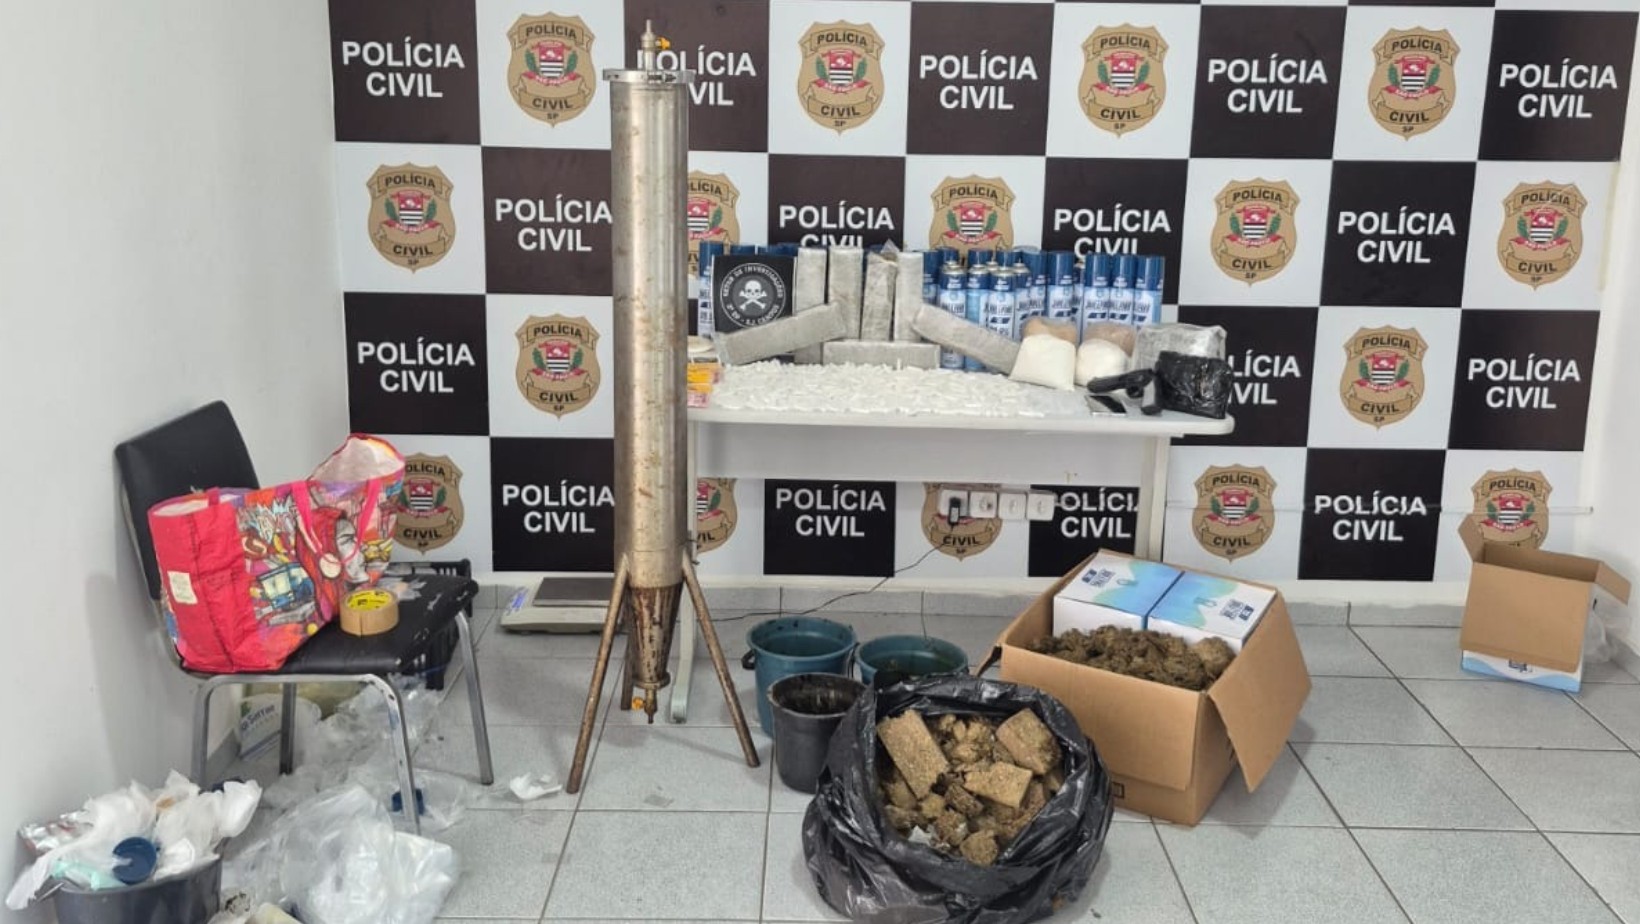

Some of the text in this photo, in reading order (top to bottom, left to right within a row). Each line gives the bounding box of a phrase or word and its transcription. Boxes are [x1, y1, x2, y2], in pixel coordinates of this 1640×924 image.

[525, 23, 577, 39] POLÍCIA
[817, 30, 867, 46] POLÍCIA
[1100, 34, 1151, 50] POLÍCIA
[342, 36, 465, 68] POLÍCIA
[1392, 37, 1442, 53] POLÍCIA
[919, 49, 1038, 81] POLÍCIA
[1207, 53, 1328, 84] POLÍCIA
[1499, 57, 1618, 89] POLÍCIA
[366, 71, 443, 98] CIVIL
[688, 81, 734, 106] VIL
[532, 97, 573, 109] CIVIL
[939, 84, 1014, 109] CIVIL
[1227, 88, 1303, 113] CIVIL
[1518, 93, 1593, 119] CIVIL
[821, 105, 861, 117] CIVIL
[1100, 108, 1141, 120] CIVIL
[1389, 111, 1430, 123] CIVIL
[385, 173, 436, 188] POLÍCIA
[689, 179, 722, 194] LÍCIA
[949, 184, 999, 199] POLÍCIA
[1232, 187, 1283, 202] POLÍCIA
[1521, 191, 1570, 205] POLÍCIA
[495, 193, 612, 225] POLÍCIA
[779, 200, 895, 230] POLÍCIA
[1054, 203, 1171, 233] POLÍCIA
[1337, 205, 1456, 236] POLÍCIA
[393, 244, 433, 256] CIVIL
[517, 227, 593, 252] CIVIL
[1357, 239, 1431, 264] CIVIL
[1231, 258, 1272, 270] CIVIL
[1517, 260, 1558, 273] CIVIL
[533, 322, 582, 337] POLÍCIA
[357, 336, 475, 367] POLÍCIA
[1362, 334, 1411, 349] POLÍCIA
[1227, 348, 1302, 378] LÍCIA
[1468, 353, 1582, 382] POLÍCIA
[380, 369, 454, 393] CIVIL
[539, 391, 578, 404] CIVIL
[1228, 382, 1278, 405] VIL
[1486, 386, 1557, 409] CIVIL
[1360, 403, 1400, 414] CIVIL
[404, 461, 445, 476] OLÍCIA
[1212, 472, 1260, 487] POLÍCIA
[502, 479, 616, 507] POLÍCIA
[1490, 477, 1537, 491] POLÍCIA
[776, 483, 887, 512] POLÍCIA
[1060, 487, 1139, 512] OLÍCI
[1314, 490, 1428, 516] POLÍCIA
[523, 511, 595, 533] CIVIL
[795, 514, 865, 537] CIVIL
[1060, 515, 1132, 538] CIVIL
[1332, 519, 1404, 542] CIVIL
[403, 529, 440, 540] CIVIL
[942, 536, 980, 546] CIVIL
[1212, 535, 1251, 548] CIVIL
